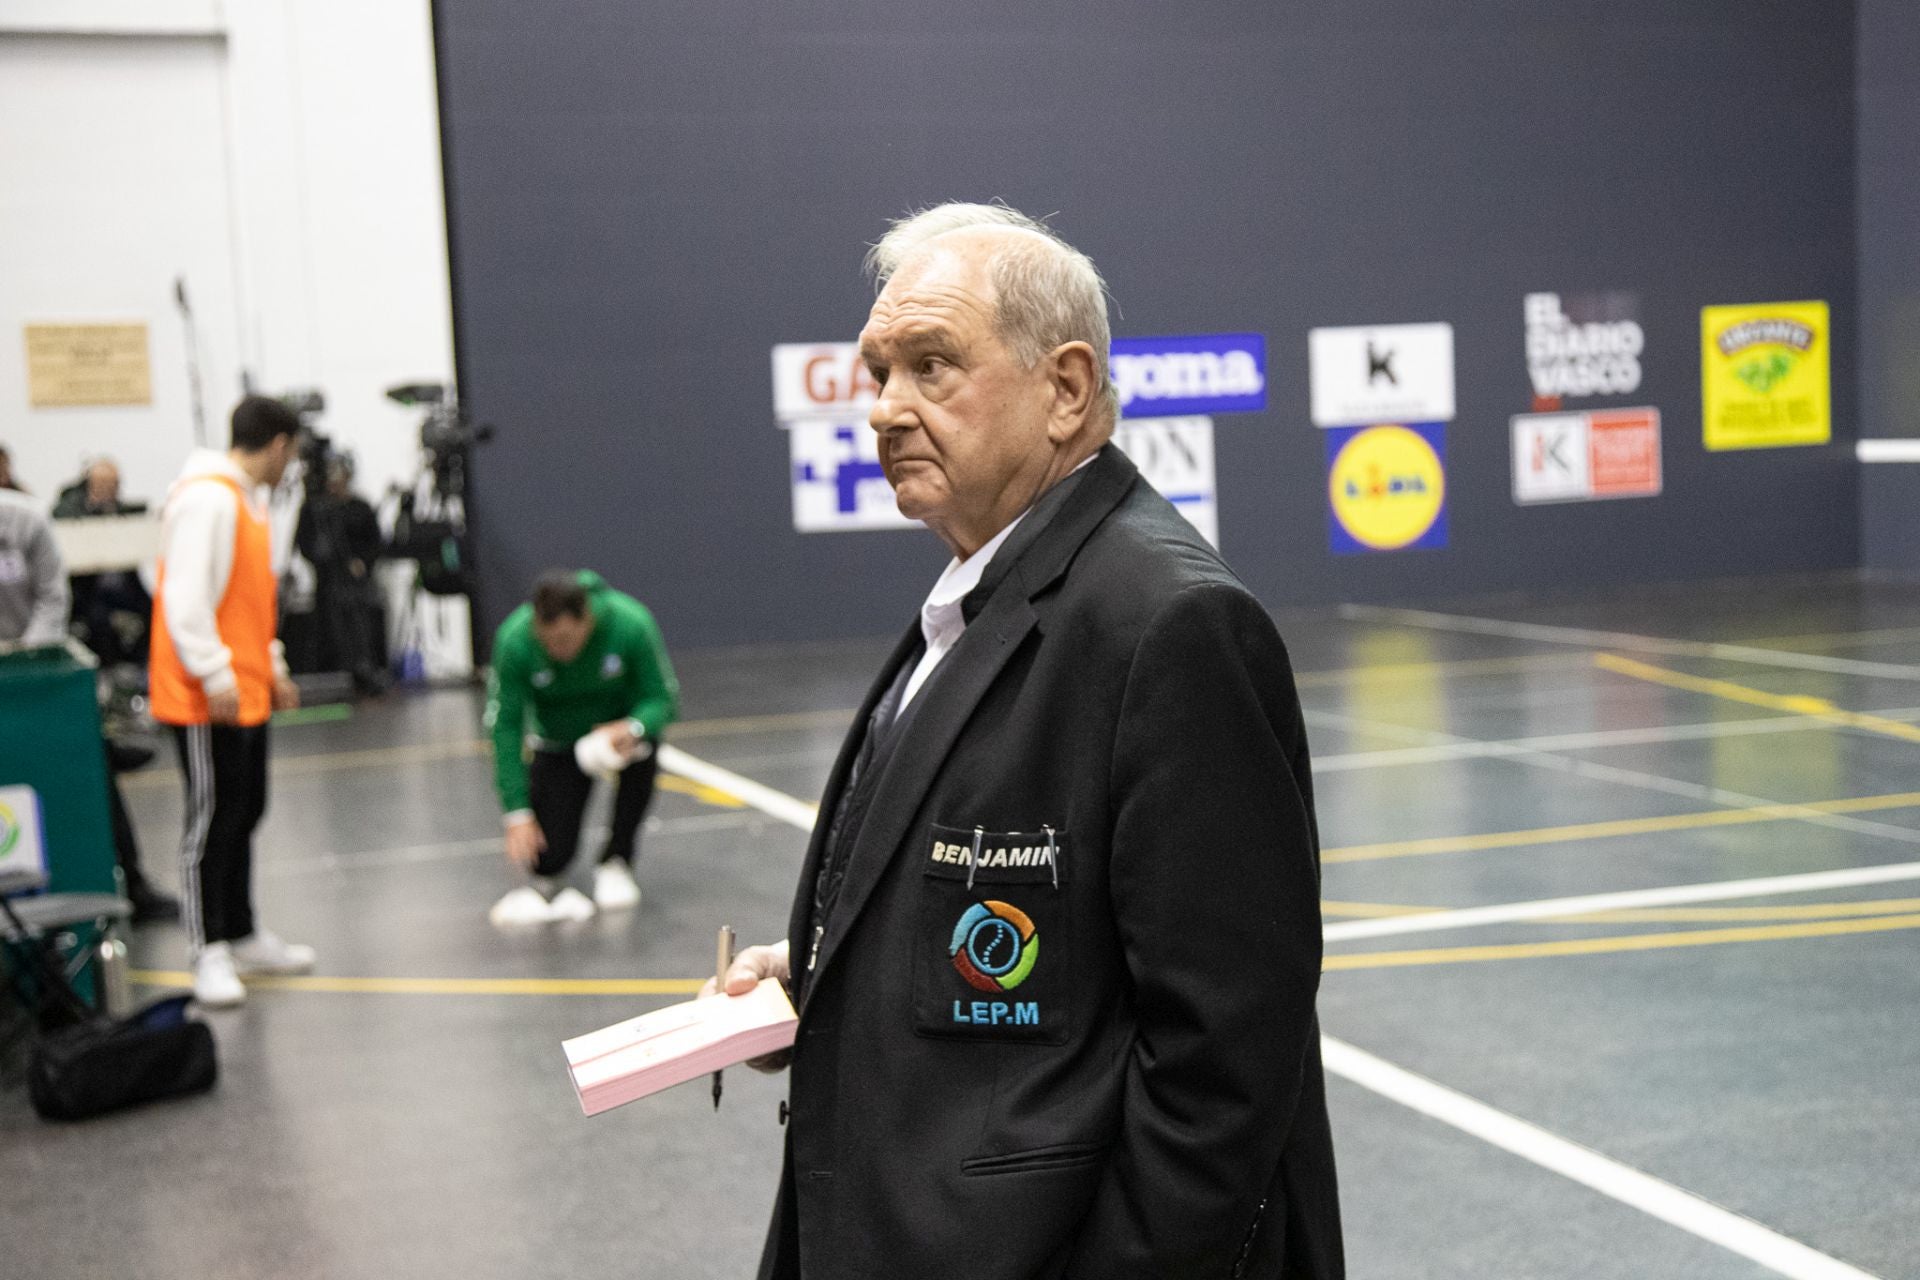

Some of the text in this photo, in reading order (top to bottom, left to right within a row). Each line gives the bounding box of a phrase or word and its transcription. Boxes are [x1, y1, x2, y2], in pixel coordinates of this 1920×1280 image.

[1525, 320, 1645, 362] DIARIO
[1529, 356, 1642, 396] VASCO
[931, 841, 1060, 867] BENJAMIN
[953, 1000, 1040, 1025] LEP.M
